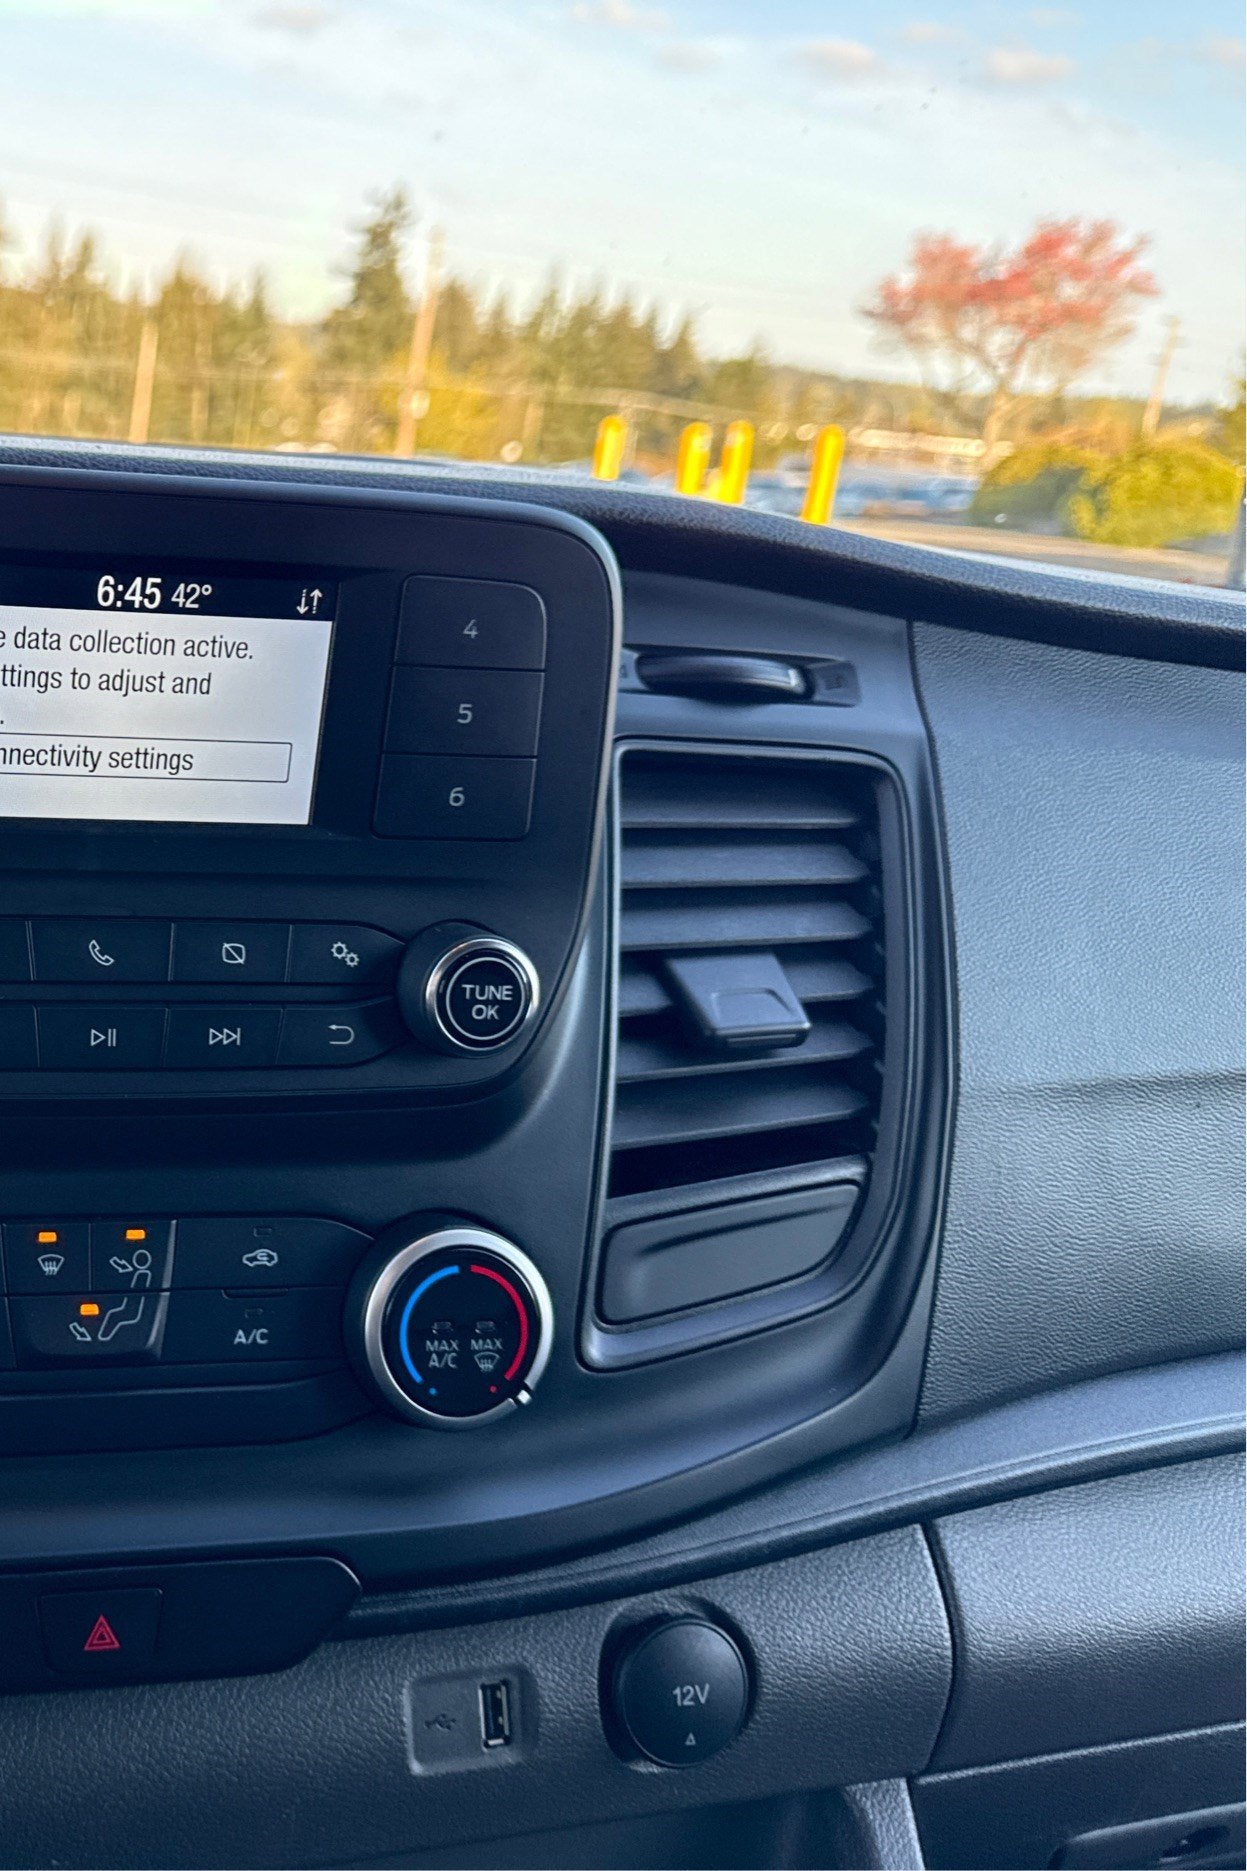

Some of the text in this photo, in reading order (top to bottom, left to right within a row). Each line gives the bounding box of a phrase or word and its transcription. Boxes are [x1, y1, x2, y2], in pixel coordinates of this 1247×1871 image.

[96, 575, 162, 610] 6:45
[462, 619, 479, 639] 4
[13, 625, 62, 651] data
[69, 629, 176, 657] collection
[183, 634, 254, 660] active.
[70, 667, 91, 691] to
[98, 667, 166, 698] adjust
[171, 672, 212, 696] and
[457, 703, 473, 724] 5
[107, 747, 194, 776] settings
[448, 786, 466, 807] 6
[461, 984, 514, 1001] TUNE
[471, 1004, 500, 1020] OK
[233, 1328, 269, 1345] A/C
[425, 1338, 459, 1353] MAX
[470, 1338, 503, 1352] MAX
[428, 1353, 457, 1369] A/C
[671, 1682, 711, 1706] 12V
